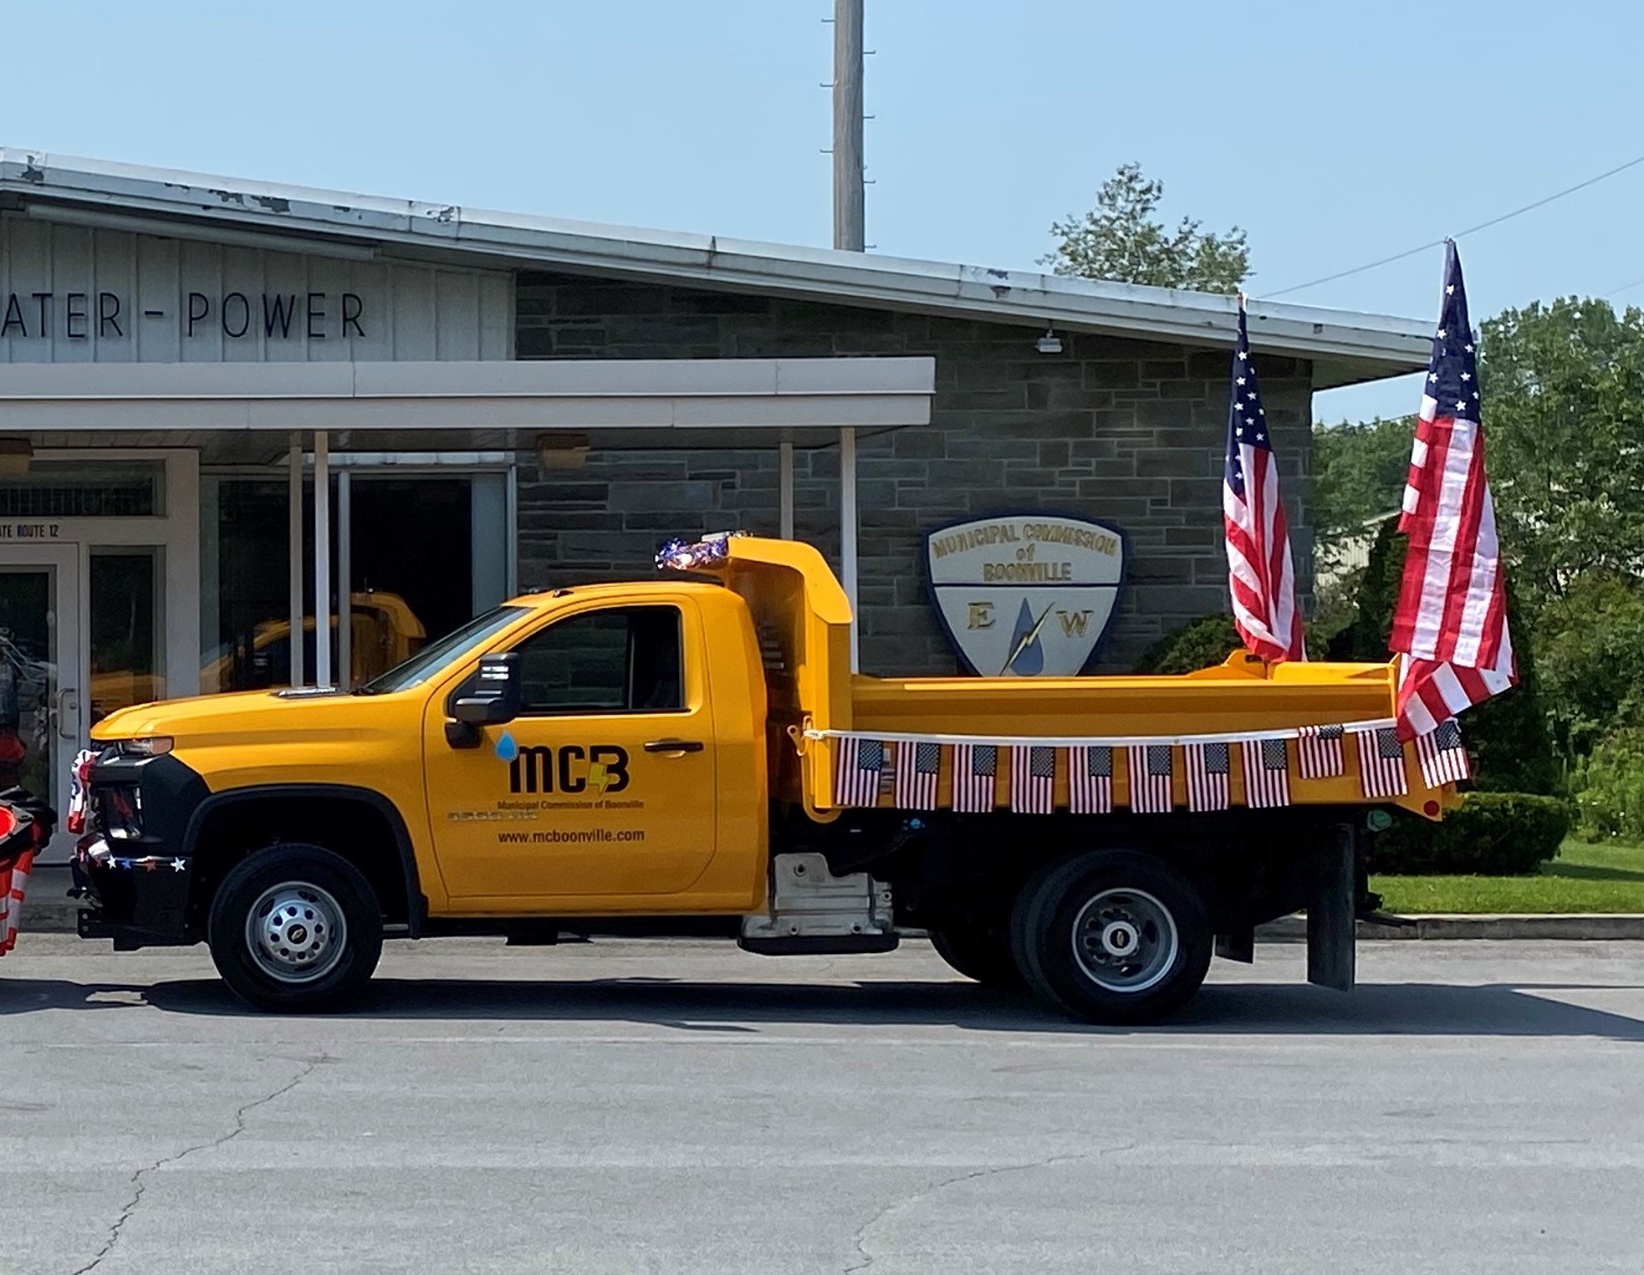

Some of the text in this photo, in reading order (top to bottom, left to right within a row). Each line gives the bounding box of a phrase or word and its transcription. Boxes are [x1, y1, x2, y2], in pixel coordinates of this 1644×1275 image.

[188, 292, 366, 339] POWER
[17, 525, 45, 538] ROUTE
[49, 525, 59, 538] 12
[932, 524, 1117, 559] MUNICIPAL COMMISSION
[1016, 544, 1036, 561] of
[983, 562, 1072, 582] BOONVILLE
[967, 602, 1094, 638] E W
[497, 801, 644, 810] Municipal Commission of Boonville
[498, 828, 644, 843] www.mcboonville.com
